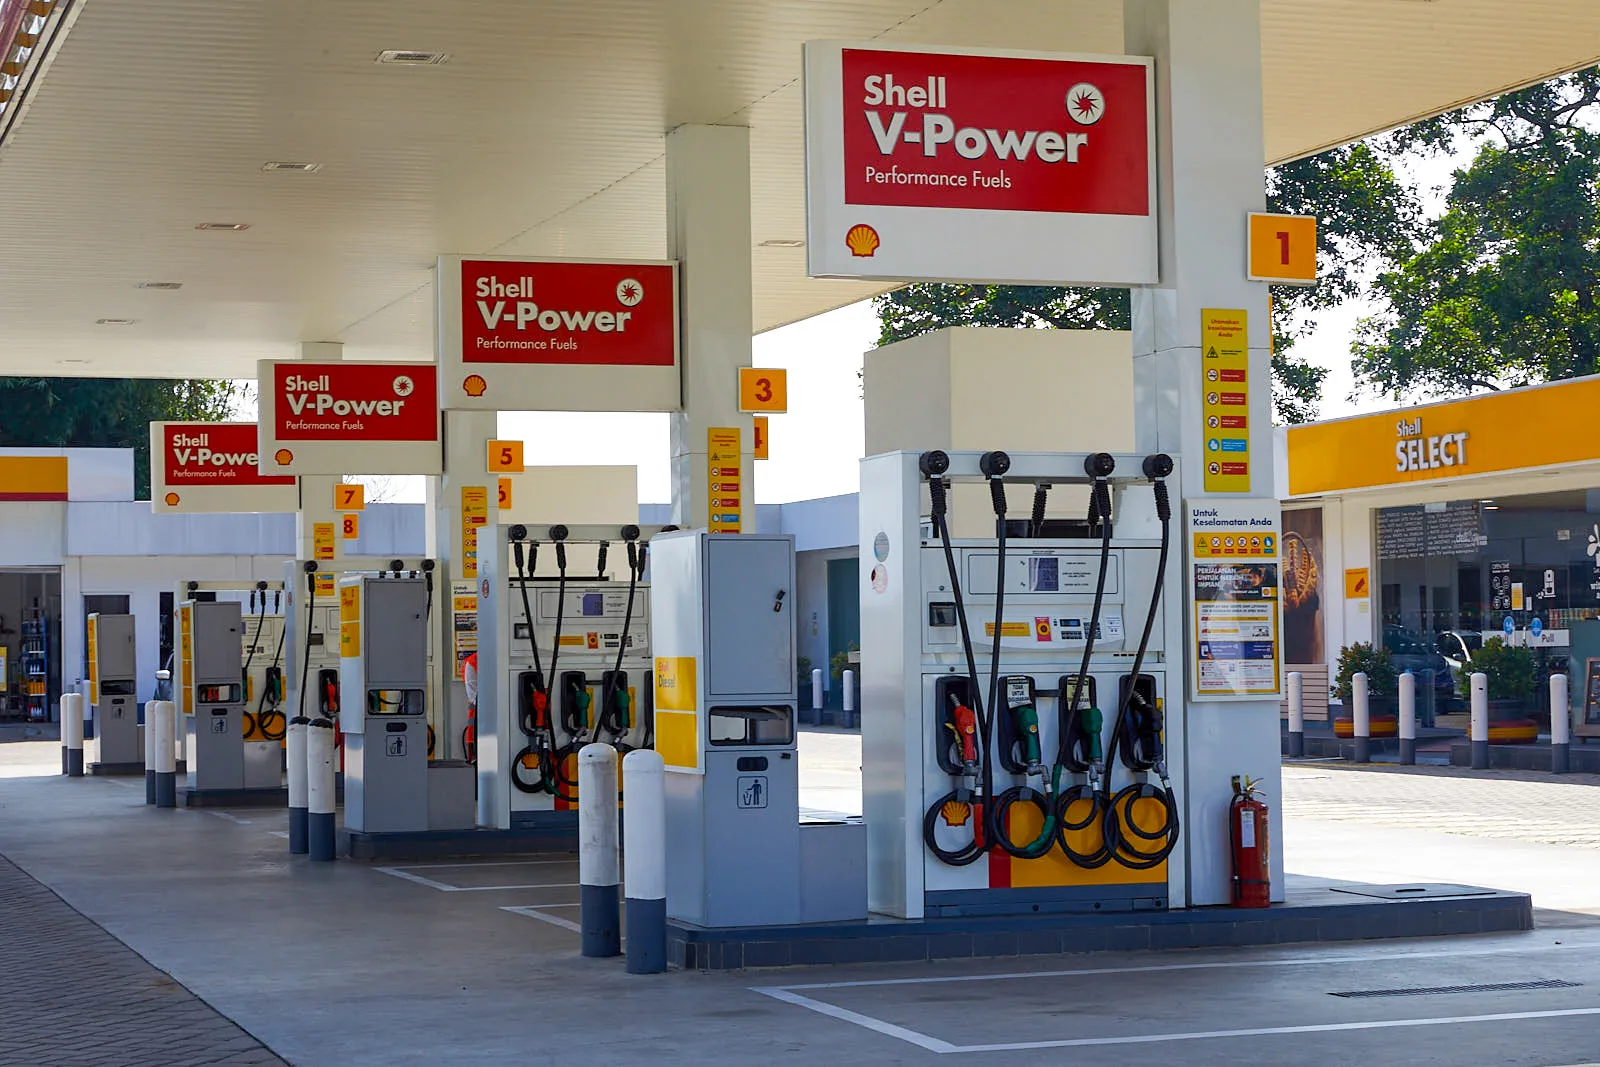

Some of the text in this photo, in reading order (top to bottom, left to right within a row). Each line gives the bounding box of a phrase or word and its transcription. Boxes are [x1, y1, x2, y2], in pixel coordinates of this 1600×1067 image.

[864, 73, 946, 108] Shell
[864, 110, 1088, 164] V-Power
[865, 166, 1012, 189] Performance Fuels
[1276, 232, 1290, 265] 1
[476, 276, 534, 298] Shell
[476, 300, 632, 332] V-Power
[476, 336, 578, 350] Performance Fuels
[285, 375, 330, 392] Shell
[755, 378, 772, 402] 3
[286, 393, 404, 416] V-Power
[286, 420, 364, 430] Performance Fuels
[1396, 416, 1422, 438] Shell
[172, 433, 208, 447] Shell
[173, 448, 258, 466] V-Powe
[500, 448, 512, 466] 5
[1396, 432, 1469, 472] SELECT
[173, 469, 236, 478] Performance Fuels
[344, 490, 355, 504] 7
[1193, 508, 1218, 517] Untuk
[344, 520, 354, 534] 8
[1250, 518, 1272, 526] Anda
